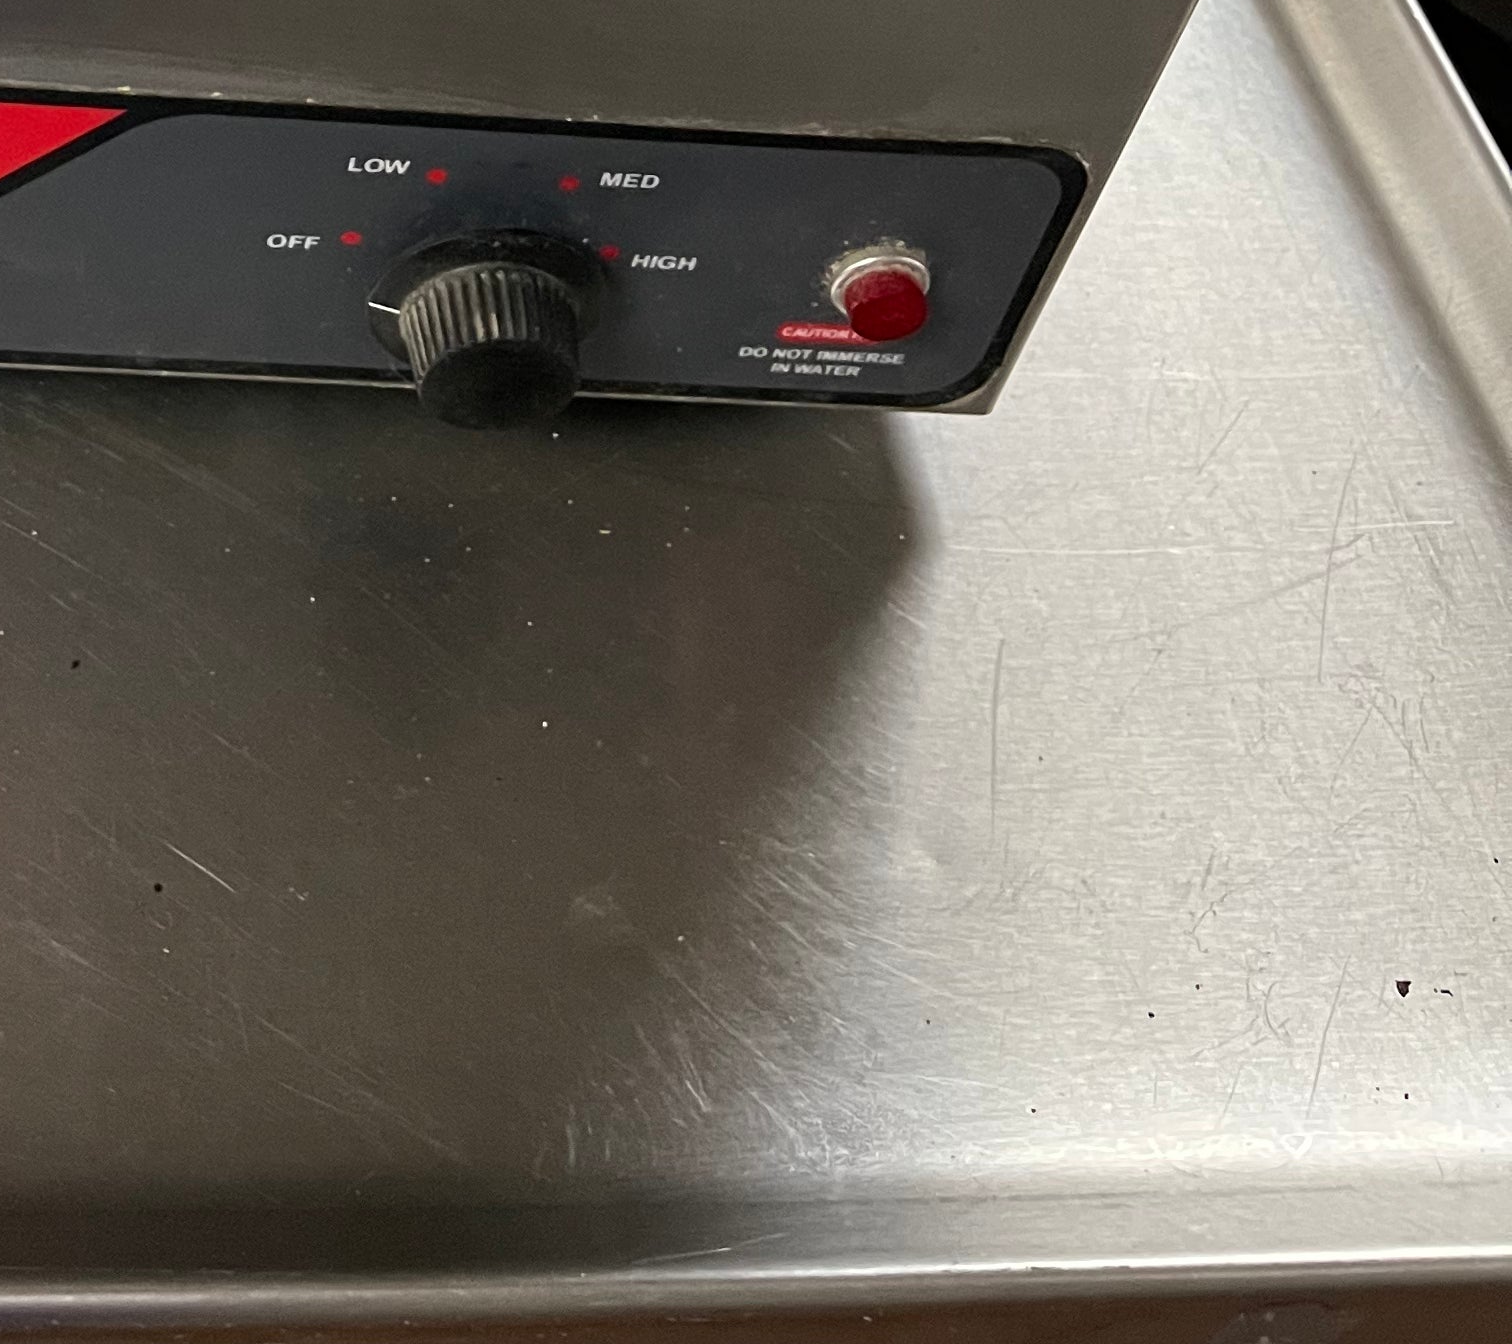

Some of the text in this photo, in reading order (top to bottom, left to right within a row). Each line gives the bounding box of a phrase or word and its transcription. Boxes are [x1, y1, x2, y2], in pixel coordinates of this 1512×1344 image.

[347, 157, 410, 174] LOW
[599, 172, 660, 189] MED
[266, 234, 320, 250] OFF
[631, 254, 698, 271] HIGH
[782, 326, 849, 339] CAUTION
[739, 346, 905, 364] DO NOT IMMERSE
[770, 362, 862, 376] IN WATER
